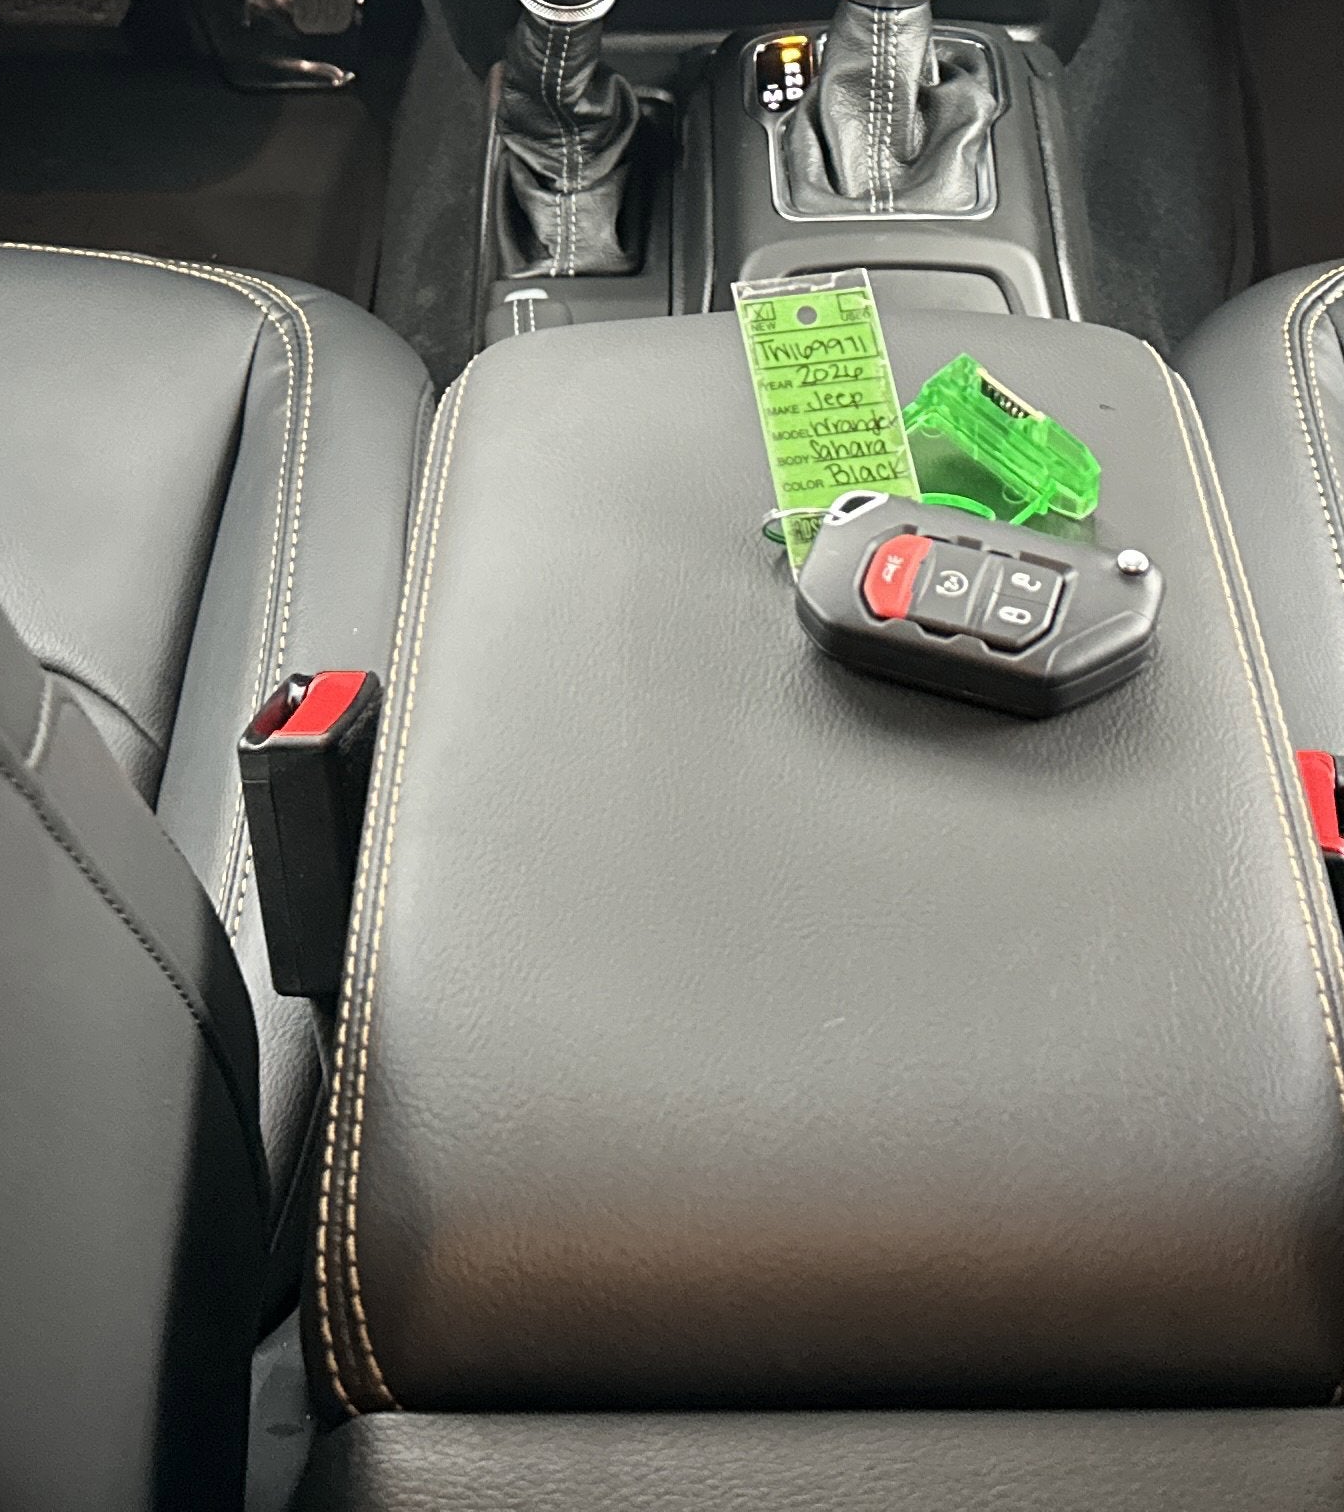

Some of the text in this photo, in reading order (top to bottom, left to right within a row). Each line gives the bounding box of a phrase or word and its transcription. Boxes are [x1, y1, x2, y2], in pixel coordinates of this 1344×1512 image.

[786, 87, 803, 100] D
[751, 321, 777, 332] NEW
[796, 363, 864, 385] 2026
[762, 380, 794, 391] YEAR
[807, 391, 864, 411] Jeep
[767, 404, 800, 416] MAKE
[772, 428, 813, 441] MODEL
[809, 439, 887, 461] Sahara
[777, 454, 810, 467] BODY
[823, 461, 908, 485] Black
[782, 478, 825, 492] COLOR
